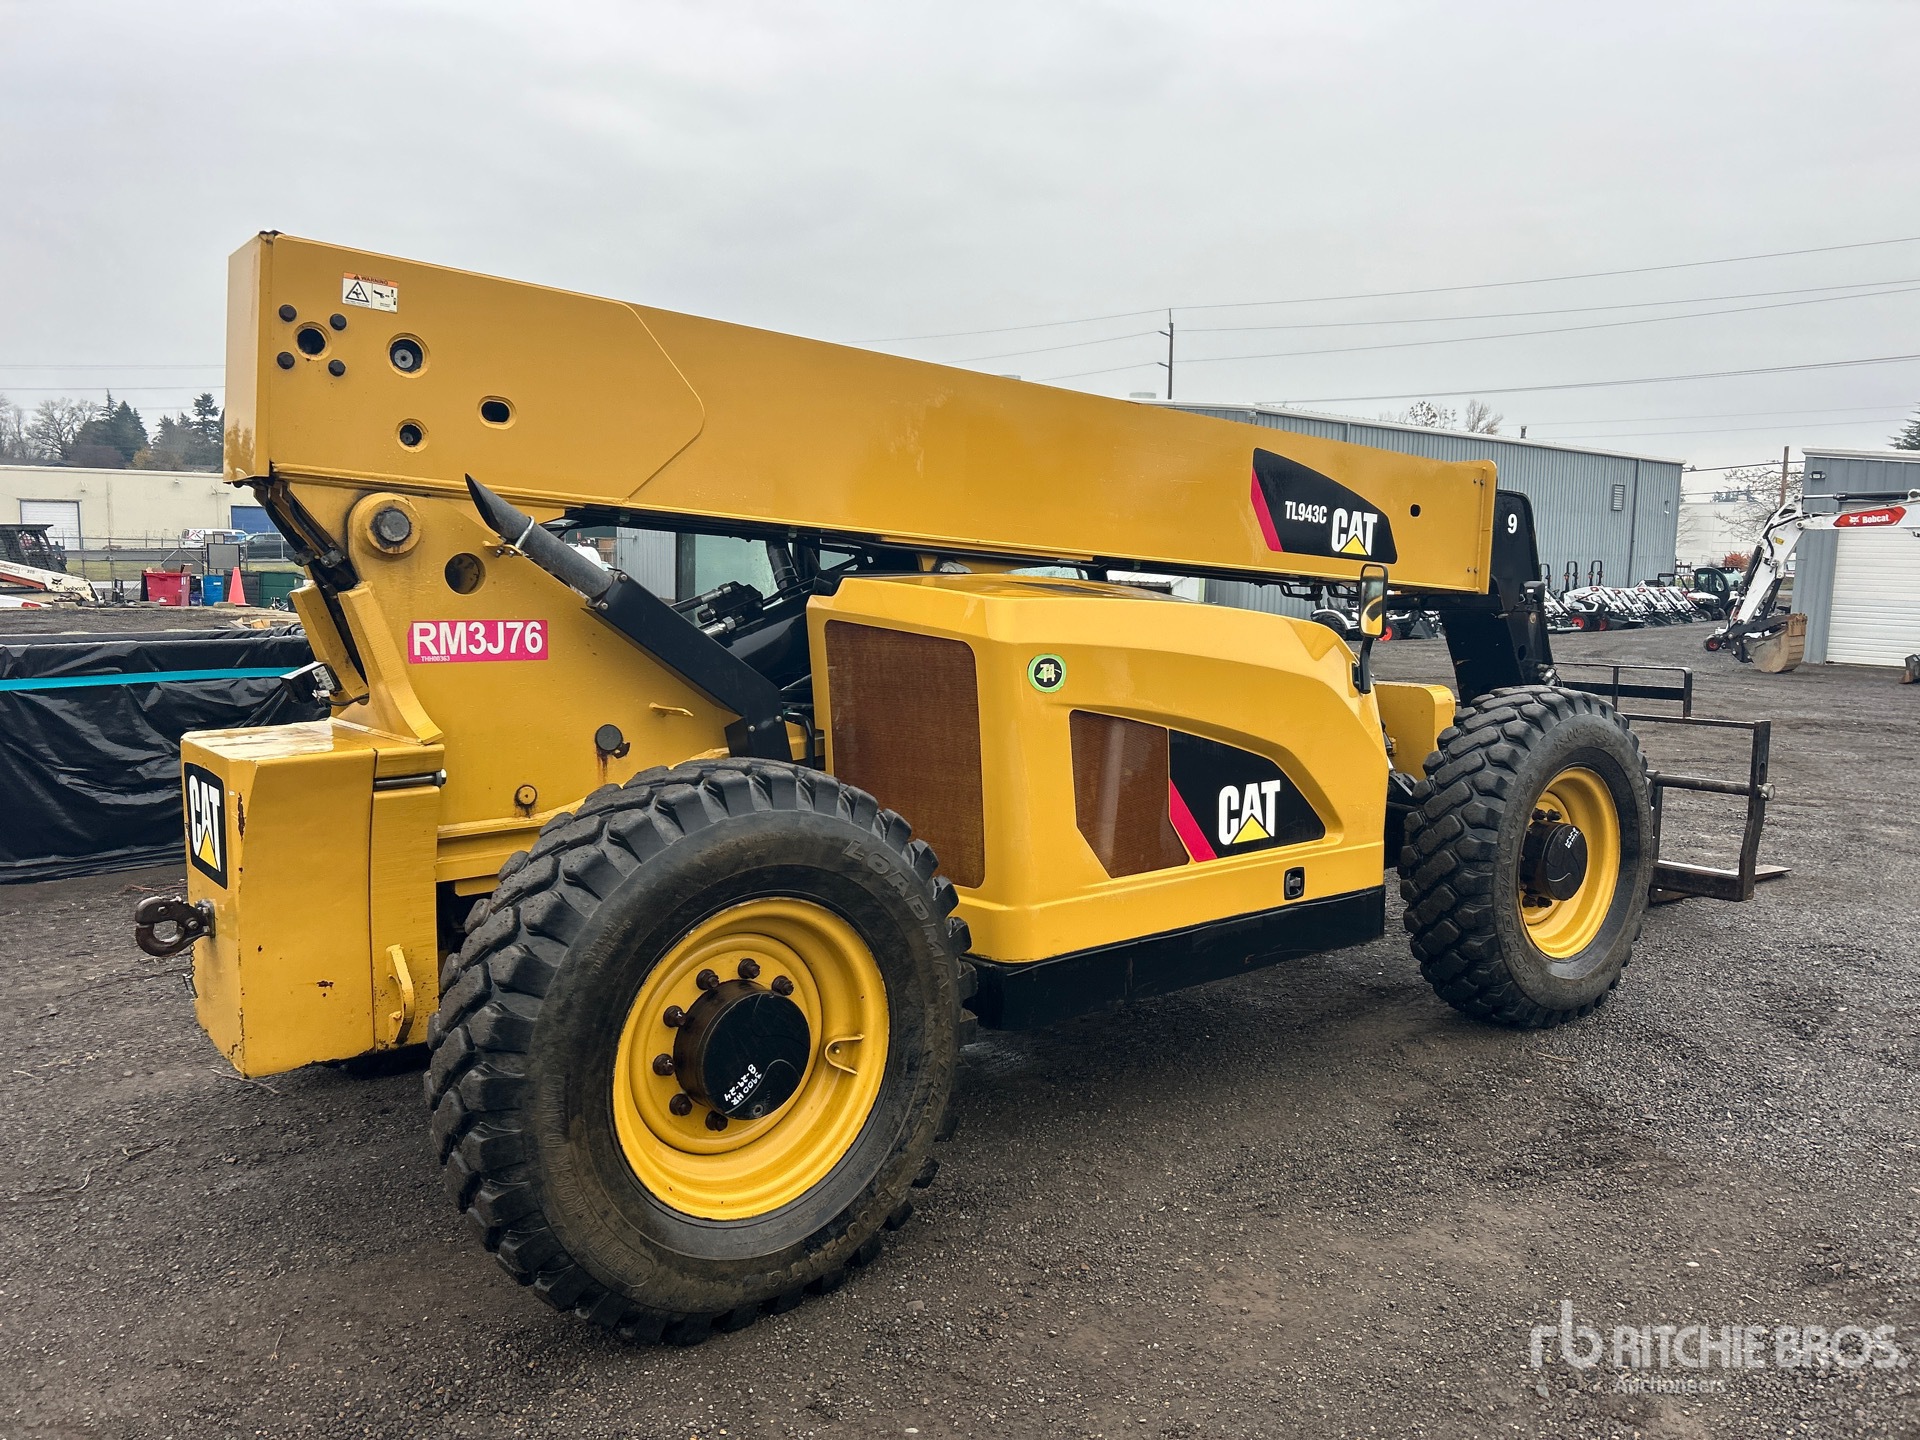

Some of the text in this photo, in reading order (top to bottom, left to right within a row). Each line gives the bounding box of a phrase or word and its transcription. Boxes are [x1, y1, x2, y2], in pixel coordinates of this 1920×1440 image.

[1284, 500, 1378, 556] TL943C CAT
[1507, 513, 1518, 534] 9
[1862, 514, 1889, 524] Bobcat
[413, 621, 543, 656] RM3J76
[189, 774, 221, 872] CAT
[1218, 779, 1281, 846] CAT
[724, 1063, 757, 1102] 8-29-24
